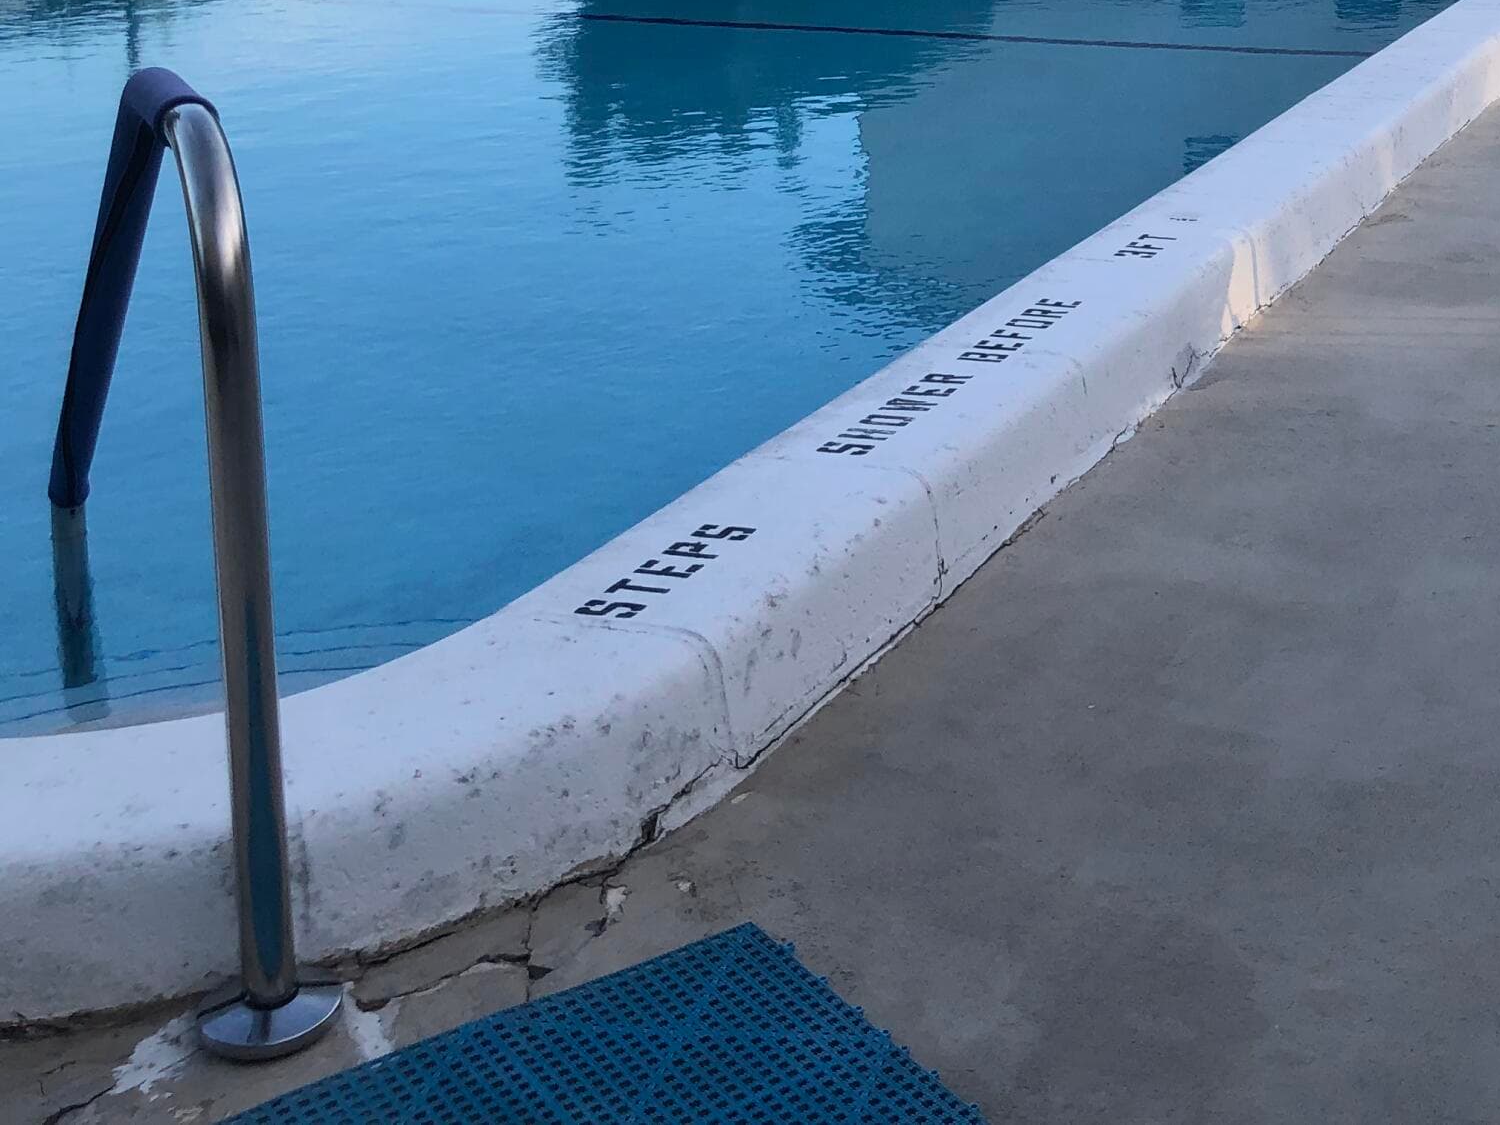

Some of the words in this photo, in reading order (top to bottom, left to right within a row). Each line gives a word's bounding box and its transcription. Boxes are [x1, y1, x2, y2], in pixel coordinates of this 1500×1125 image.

[1113, 234, 1177, 258] 3FT
[816, 373, 974, 455] SHOWER
[957, 298, 1082, 362] BEFORE
[574, 524, 757, 618] STEPS
